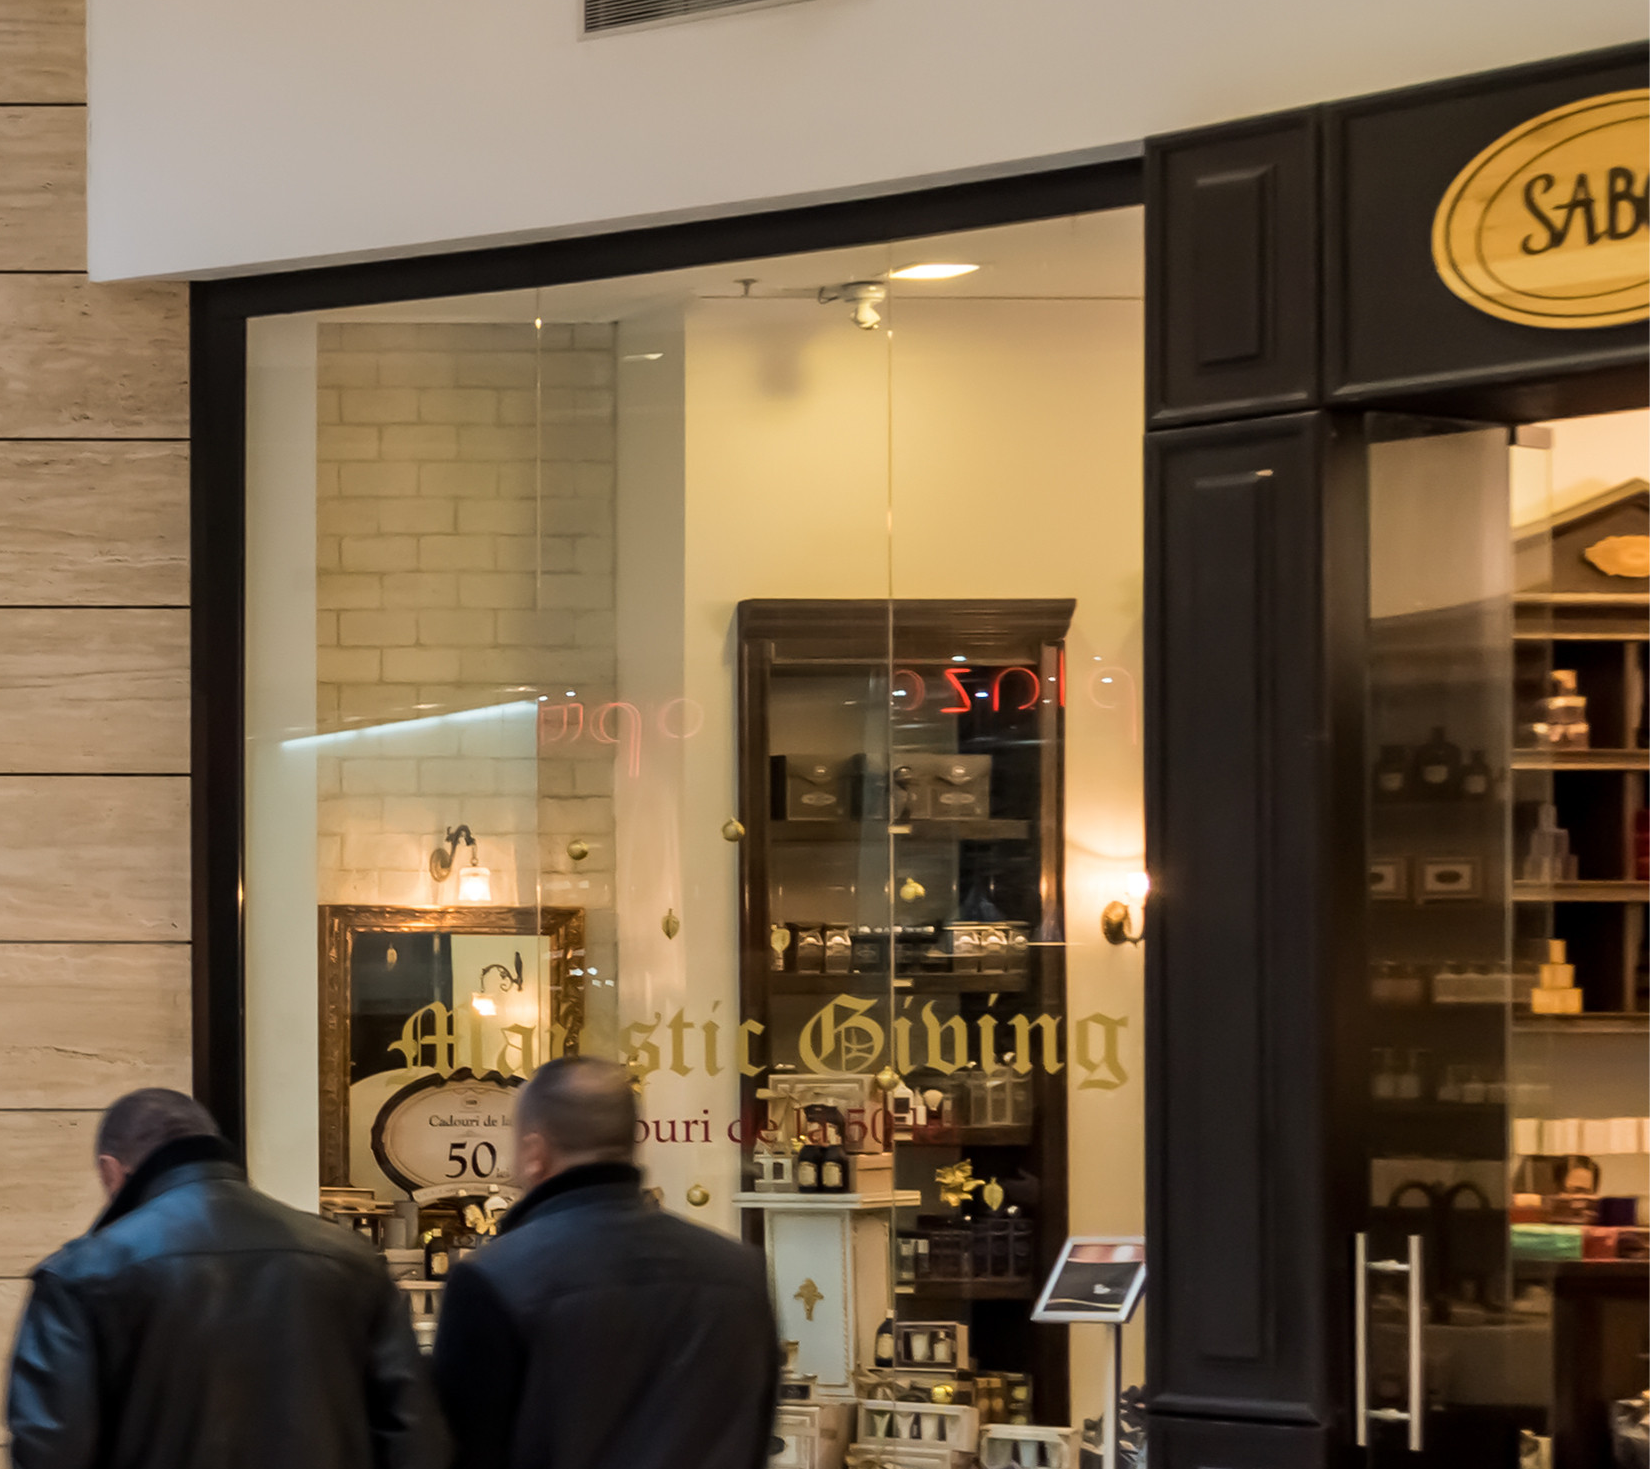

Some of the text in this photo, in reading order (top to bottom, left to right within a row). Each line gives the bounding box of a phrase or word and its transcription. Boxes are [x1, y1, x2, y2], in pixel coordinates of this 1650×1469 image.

[1521, 166, 1650, 255] SAB
[799, 993, 1129, 1091] Giving
[429, 1115, 480, 1127] Cadouri
[483, 1115, 497, 1127] de
[445, 1141, 497, 1179] 50
